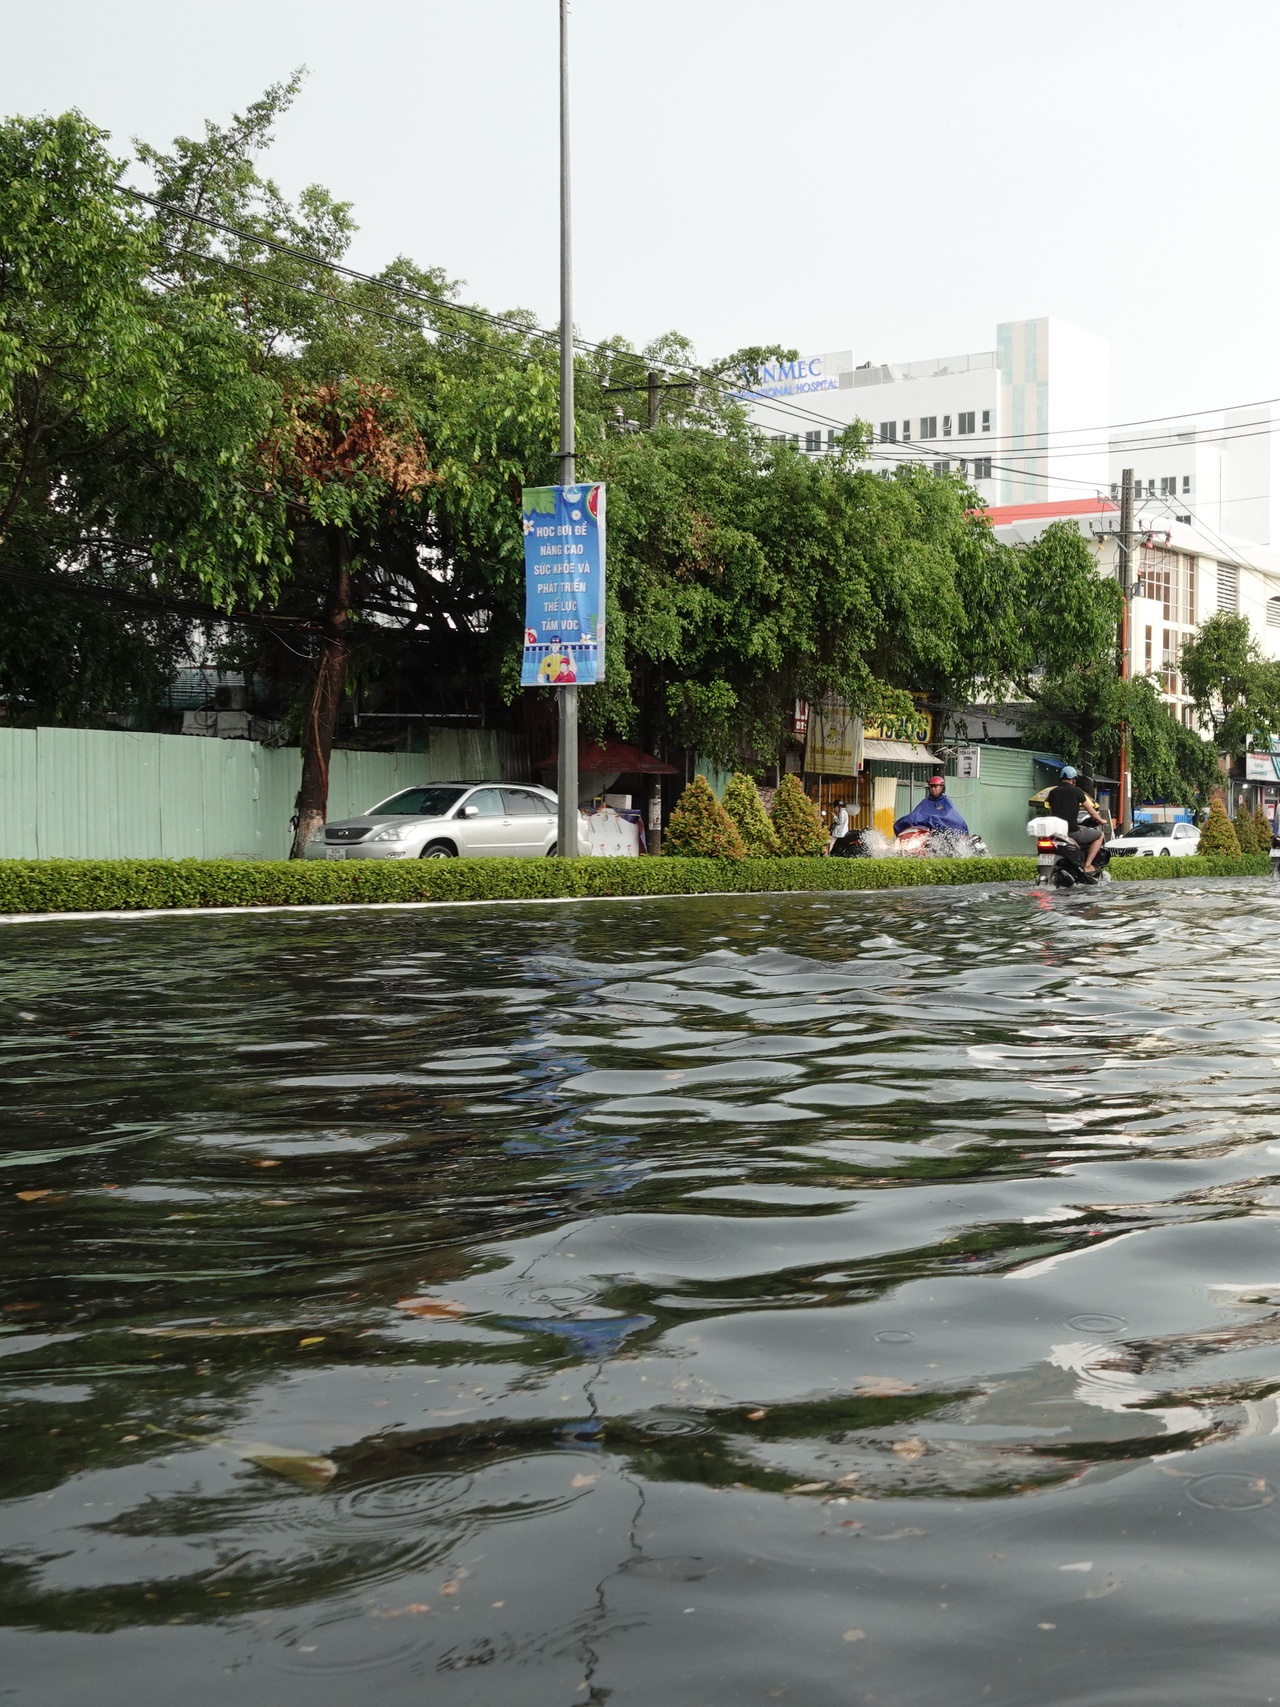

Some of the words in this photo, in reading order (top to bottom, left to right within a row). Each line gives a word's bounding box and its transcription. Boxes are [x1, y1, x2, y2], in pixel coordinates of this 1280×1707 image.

[741, 358, 821, 384] NMEC
[796, 379, 839, 395] HOSPITAL
[536, 526, 555, 539] HỌC
[574, 520, 588, 536] ĐỂ
[540, 543, 562, 556] NÂNG
[564, 544, 584, 555] CAO
[533, 562, 551, 575] SỨC
[577, 560, 591, 574] VÀ
[537, 580, 558, 594] PHÁT
[561, 599, 577, 614] LỰC
[561, 617, 579, 631] VÓC
